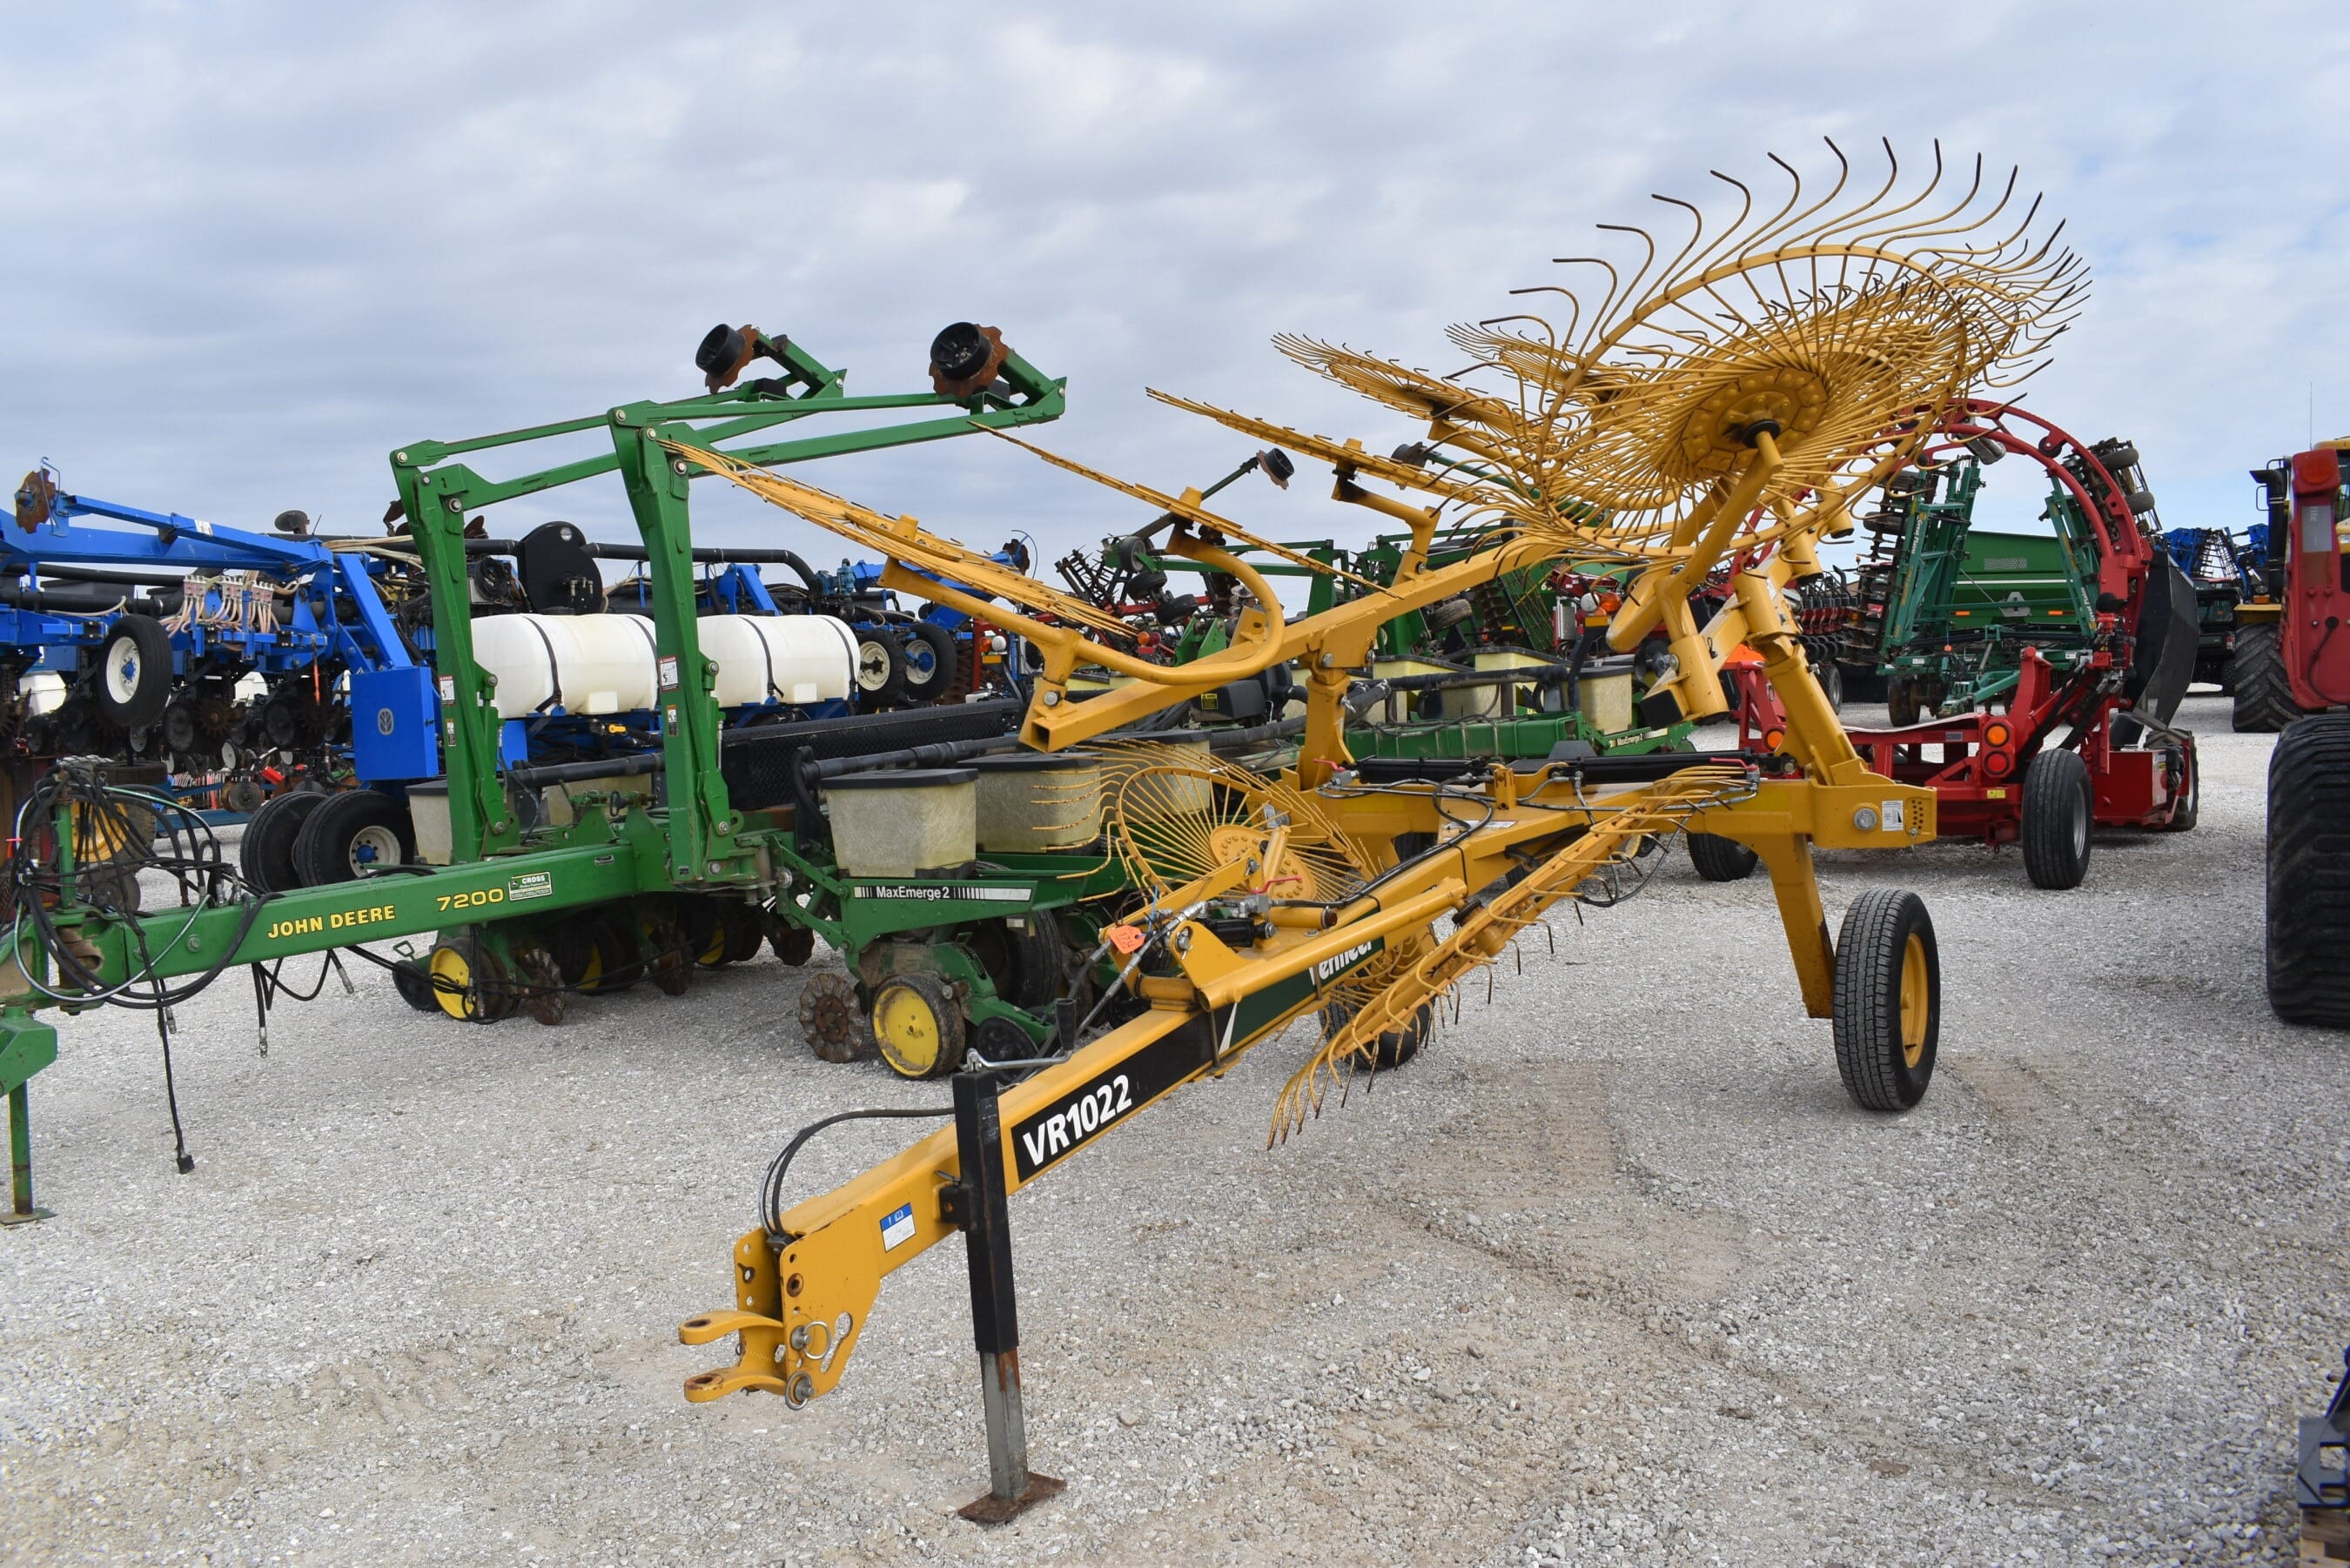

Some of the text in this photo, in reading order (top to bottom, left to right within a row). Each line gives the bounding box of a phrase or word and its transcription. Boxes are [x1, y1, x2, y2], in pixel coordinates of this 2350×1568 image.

[522, 875, 545, 884] CROSS
[436, 888, 504, 911] 7200
[876, 886, 950, 901] MaxEmerge 2
[268, 905, 395, 939] JOHN DEERE
[1023, 1075, 1131, 1166] VR1022
